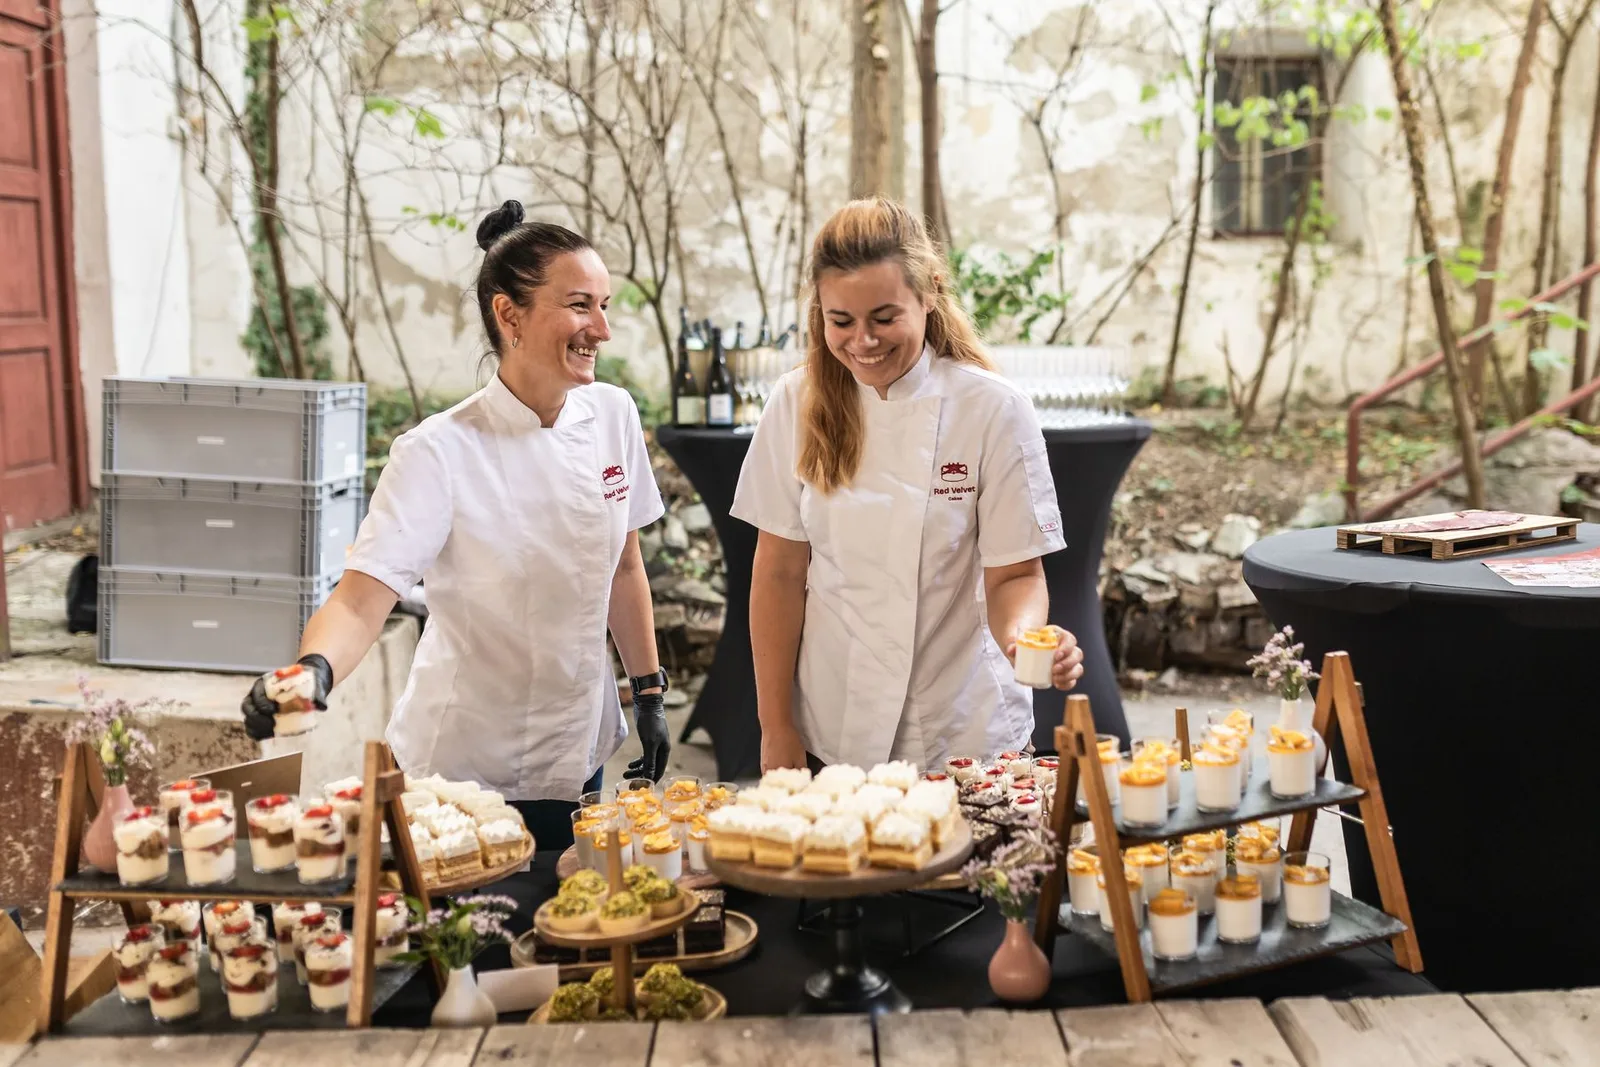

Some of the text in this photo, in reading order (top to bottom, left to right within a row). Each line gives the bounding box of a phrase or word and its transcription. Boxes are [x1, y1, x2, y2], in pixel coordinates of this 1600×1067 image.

[604, 490, 616, 500] Red
[934, 486, 976, 495] Red Velvet
